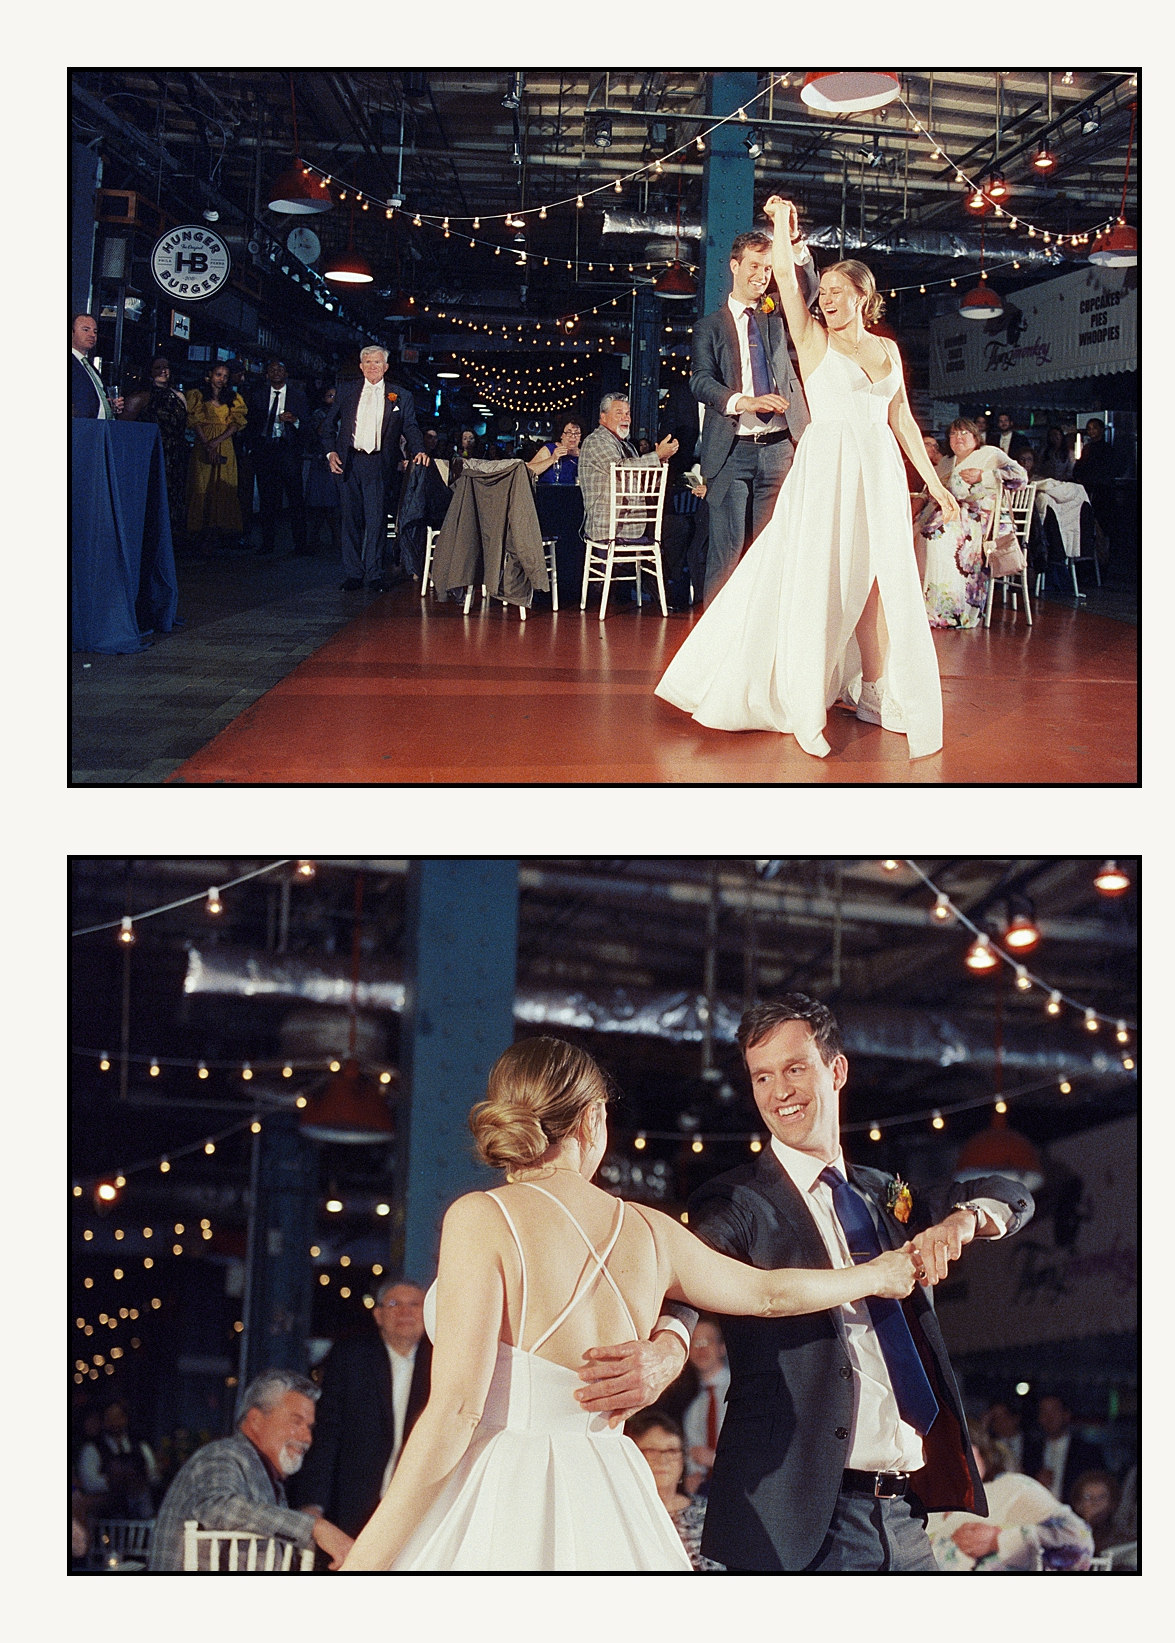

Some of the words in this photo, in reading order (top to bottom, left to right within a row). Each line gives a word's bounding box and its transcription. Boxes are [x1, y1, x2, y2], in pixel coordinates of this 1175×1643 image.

[162, 231, 221, 254] HUNGER
[175, 251, 209, 274] HB
[159, 270, 221, 294] BURGER
[1080, 291, 1121, 314] CUPCAKES
[1091, 311, 1108, 328] PIES
[1079, 325, 1120, 347] WHOOPIES
